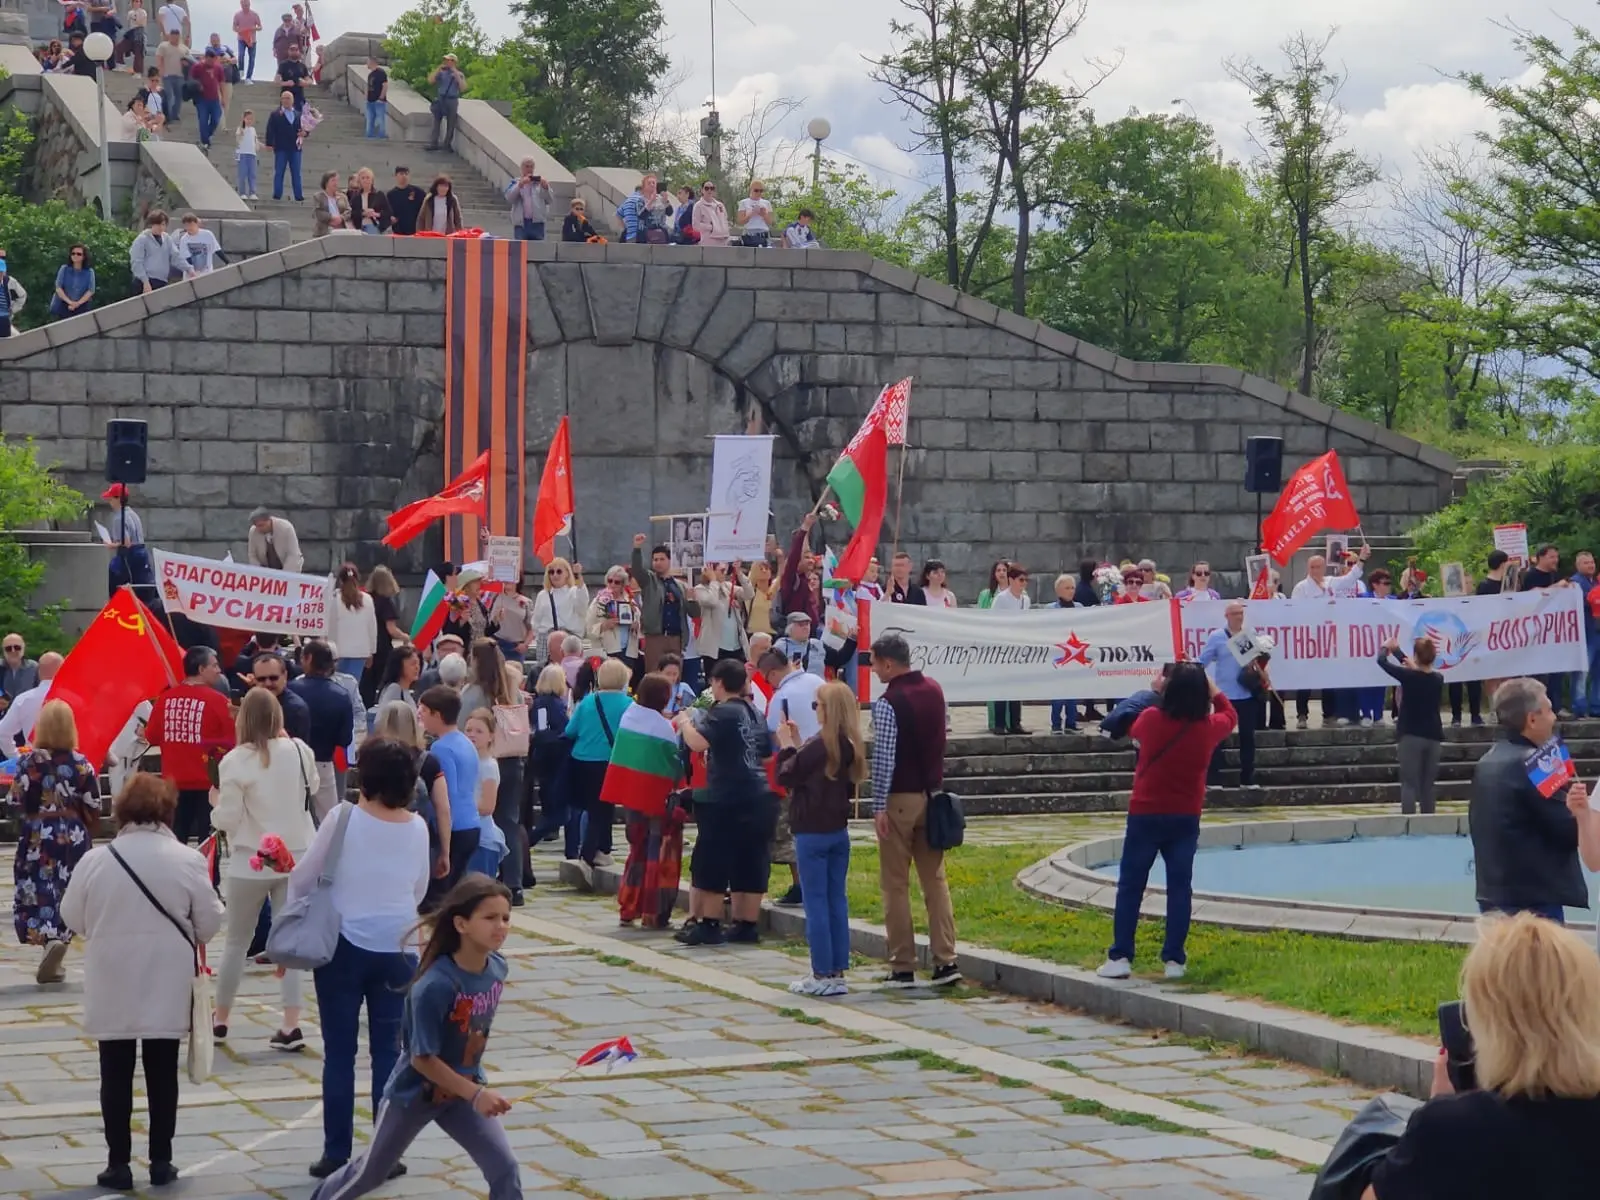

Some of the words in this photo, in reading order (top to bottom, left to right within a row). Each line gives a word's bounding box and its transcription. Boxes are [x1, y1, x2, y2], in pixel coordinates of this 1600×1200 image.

[163, 560, 289, 597] БЛАГОДАРИМ
[299, 583, 324, 601] ТИ,
[189, 592, 293, 625] РУСИЯ!
[295, 618, 324, 630] 1945
[296, 602, 325, 614] 1878
[1488, 609, 1580, 651] БОЛГАРИЯ
